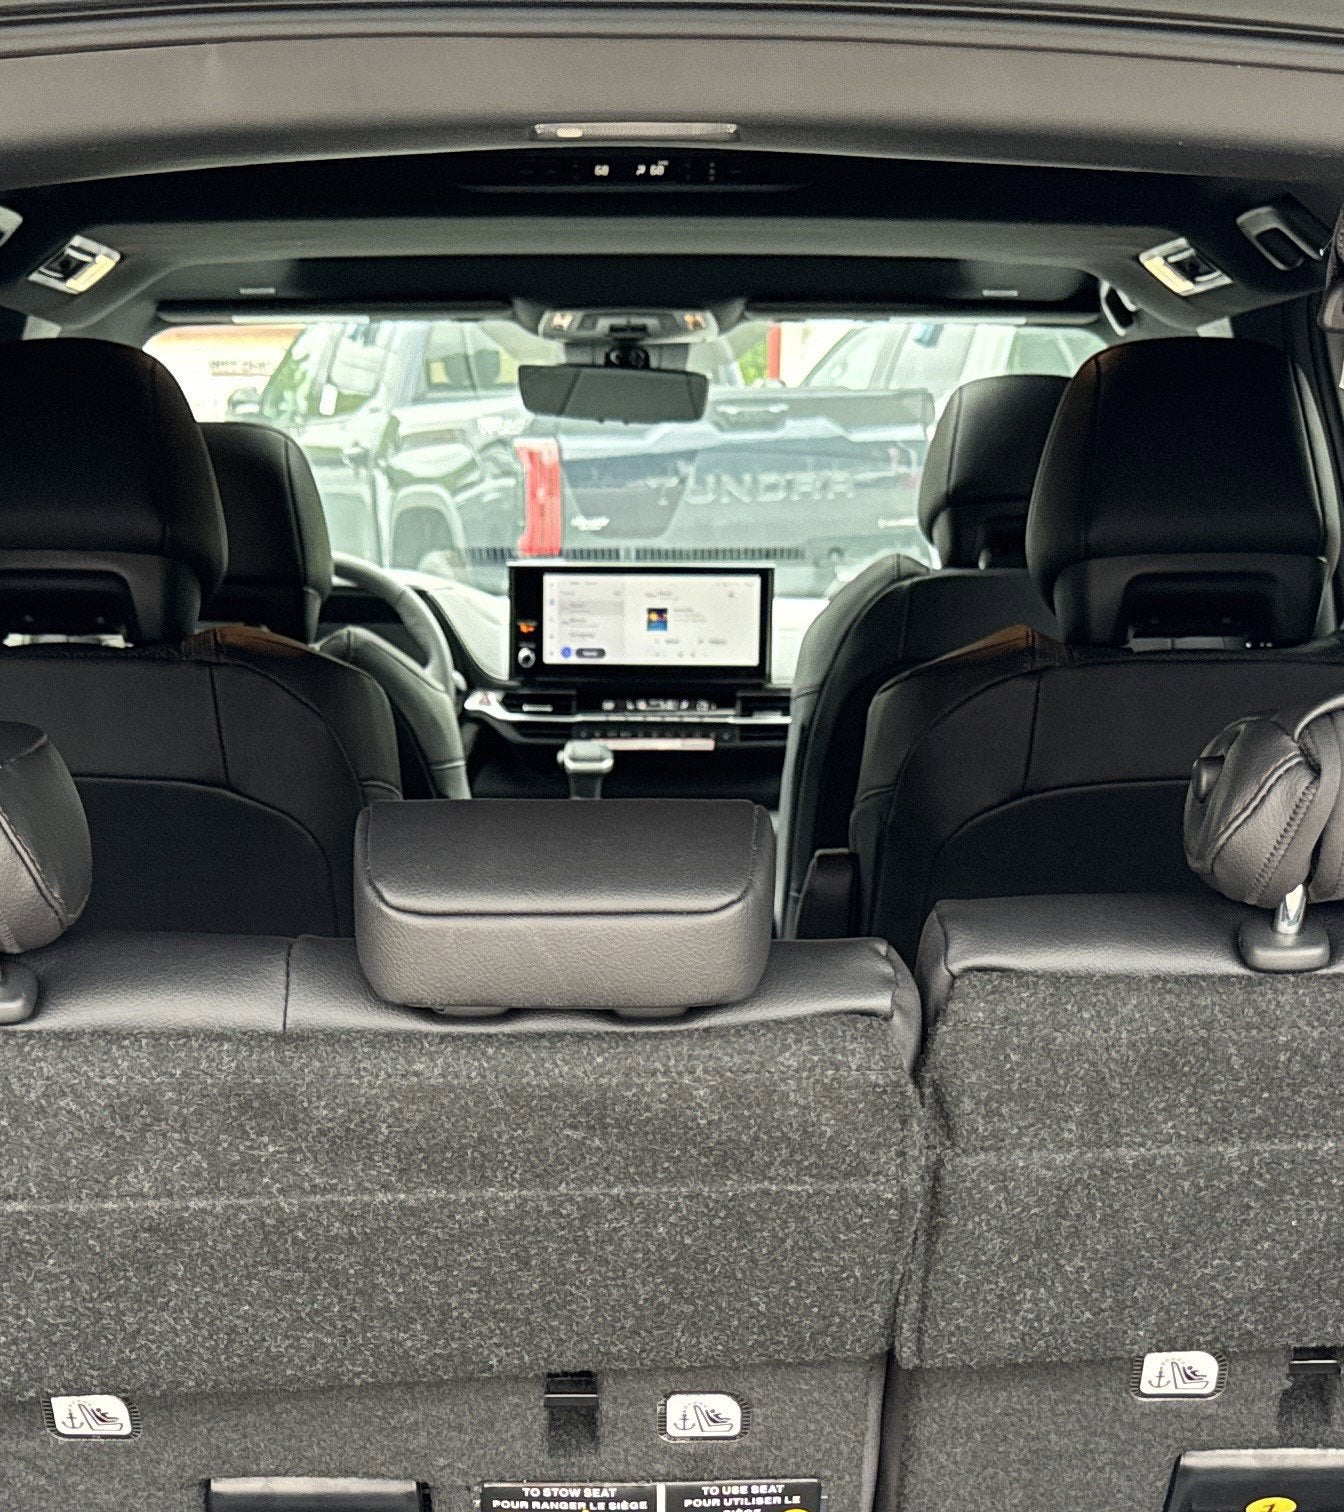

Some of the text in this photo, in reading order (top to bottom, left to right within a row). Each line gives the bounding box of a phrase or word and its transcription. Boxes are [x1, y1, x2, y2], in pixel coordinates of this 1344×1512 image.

[645, 472, 855, 506] TUNDRA
[521, 1487, 617, 1498] TO STOW SEAT
[701, 1484, 785, 1496] TO USE SEAT
[492, 1500, 648, 1511] POUR RANGER LE SIÈGE
[683, 1495, 801, 1508] POUR UTILISER LE
